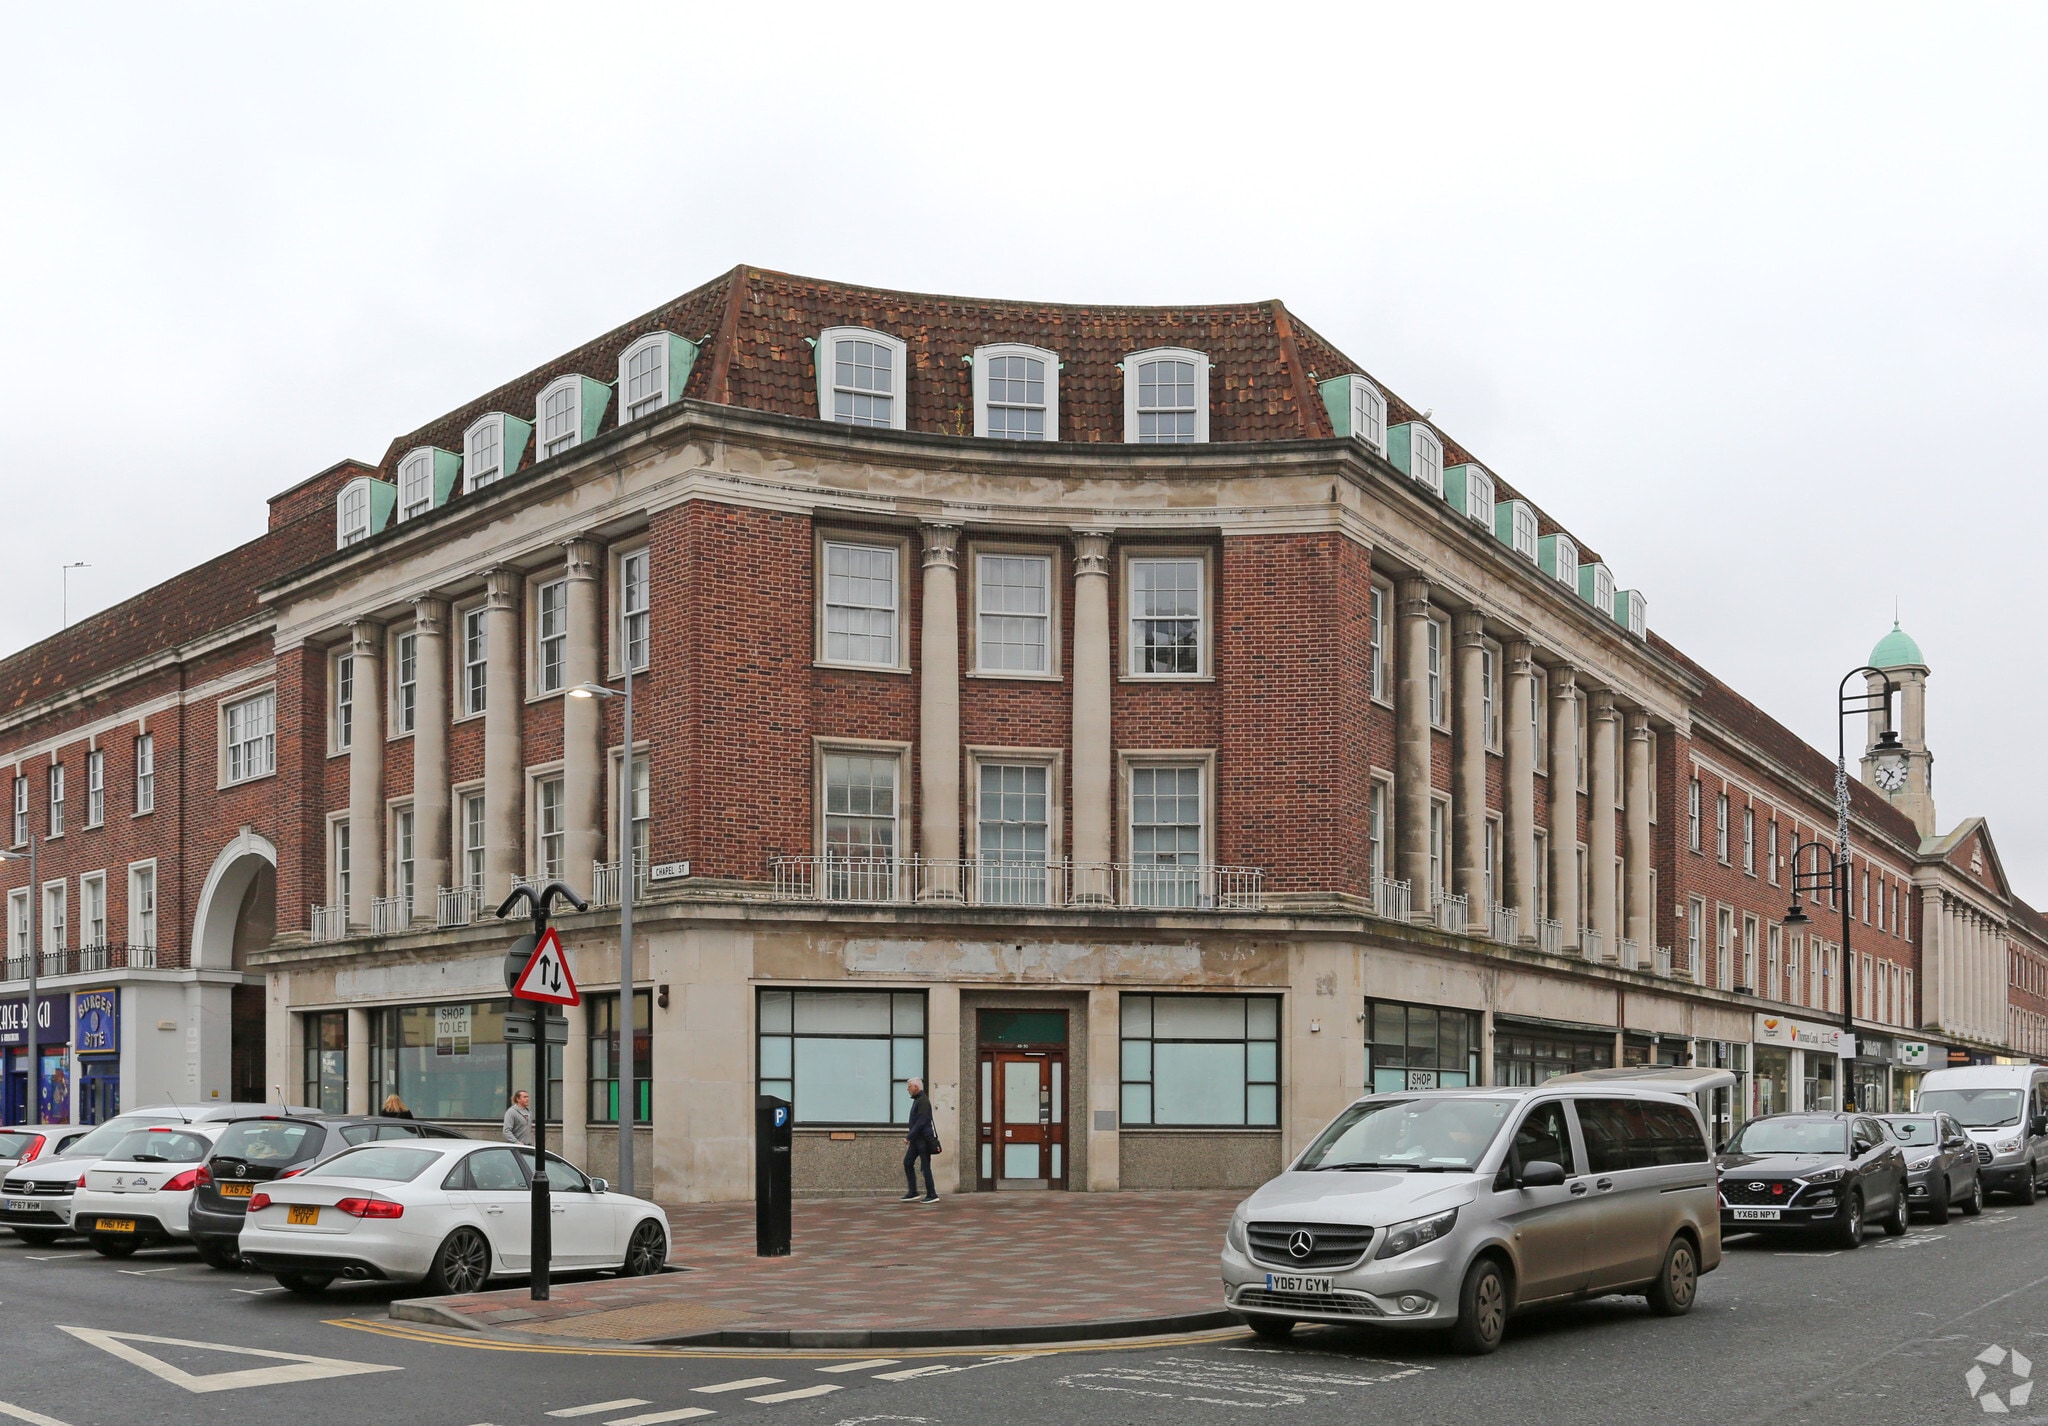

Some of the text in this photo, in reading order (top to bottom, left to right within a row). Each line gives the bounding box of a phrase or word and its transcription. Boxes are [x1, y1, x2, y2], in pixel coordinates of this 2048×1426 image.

[656, 864, 685, 876] CHAPEL ST
[78, 995, 112, 1019] BURGER
[441, 1008, 465, 1020] SHOP
[439, 1021, 468, 1033] TO LET
[84, 1031, 105, 1048] BITE
[1411, 1073, 1432, 1085] SHOP
[776, 1109, 784, 1123] P
[224, 1184, 244, 1194] YX67
[1737, 1210, 1777, 1218] YX68 NPY
[1273, 1276, 1330, 1292] YD67 GYW
